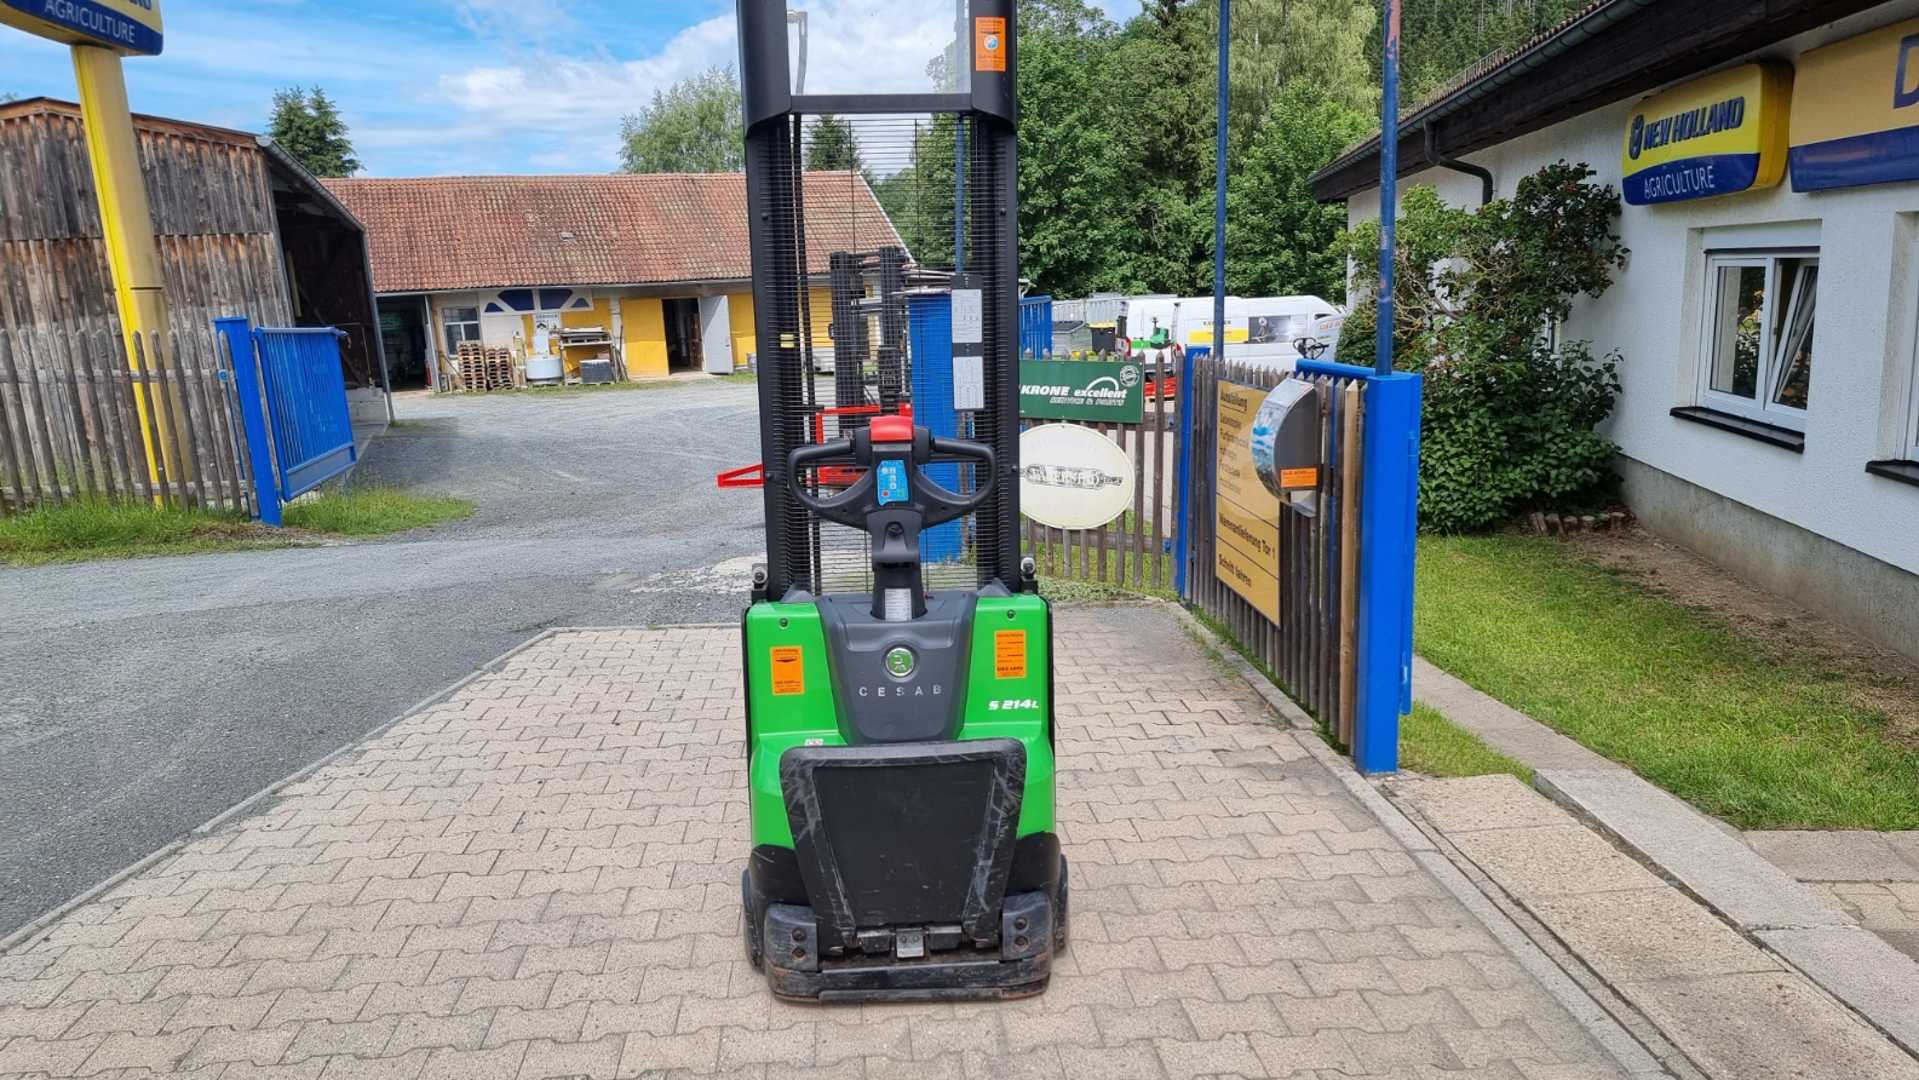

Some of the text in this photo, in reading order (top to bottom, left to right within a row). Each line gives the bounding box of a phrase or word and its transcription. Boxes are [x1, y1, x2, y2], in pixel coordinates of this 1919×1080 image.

[44, 0, 135, 43] AGRICULTURE
[1643, 96, 1745, 150] NEW HOLLAND
[1644, 165, 1715, 199] AGRICULTURE
[1020, 384, 1128, 399] KRONE excellent
[858, 684, 942, 697] CESAB
